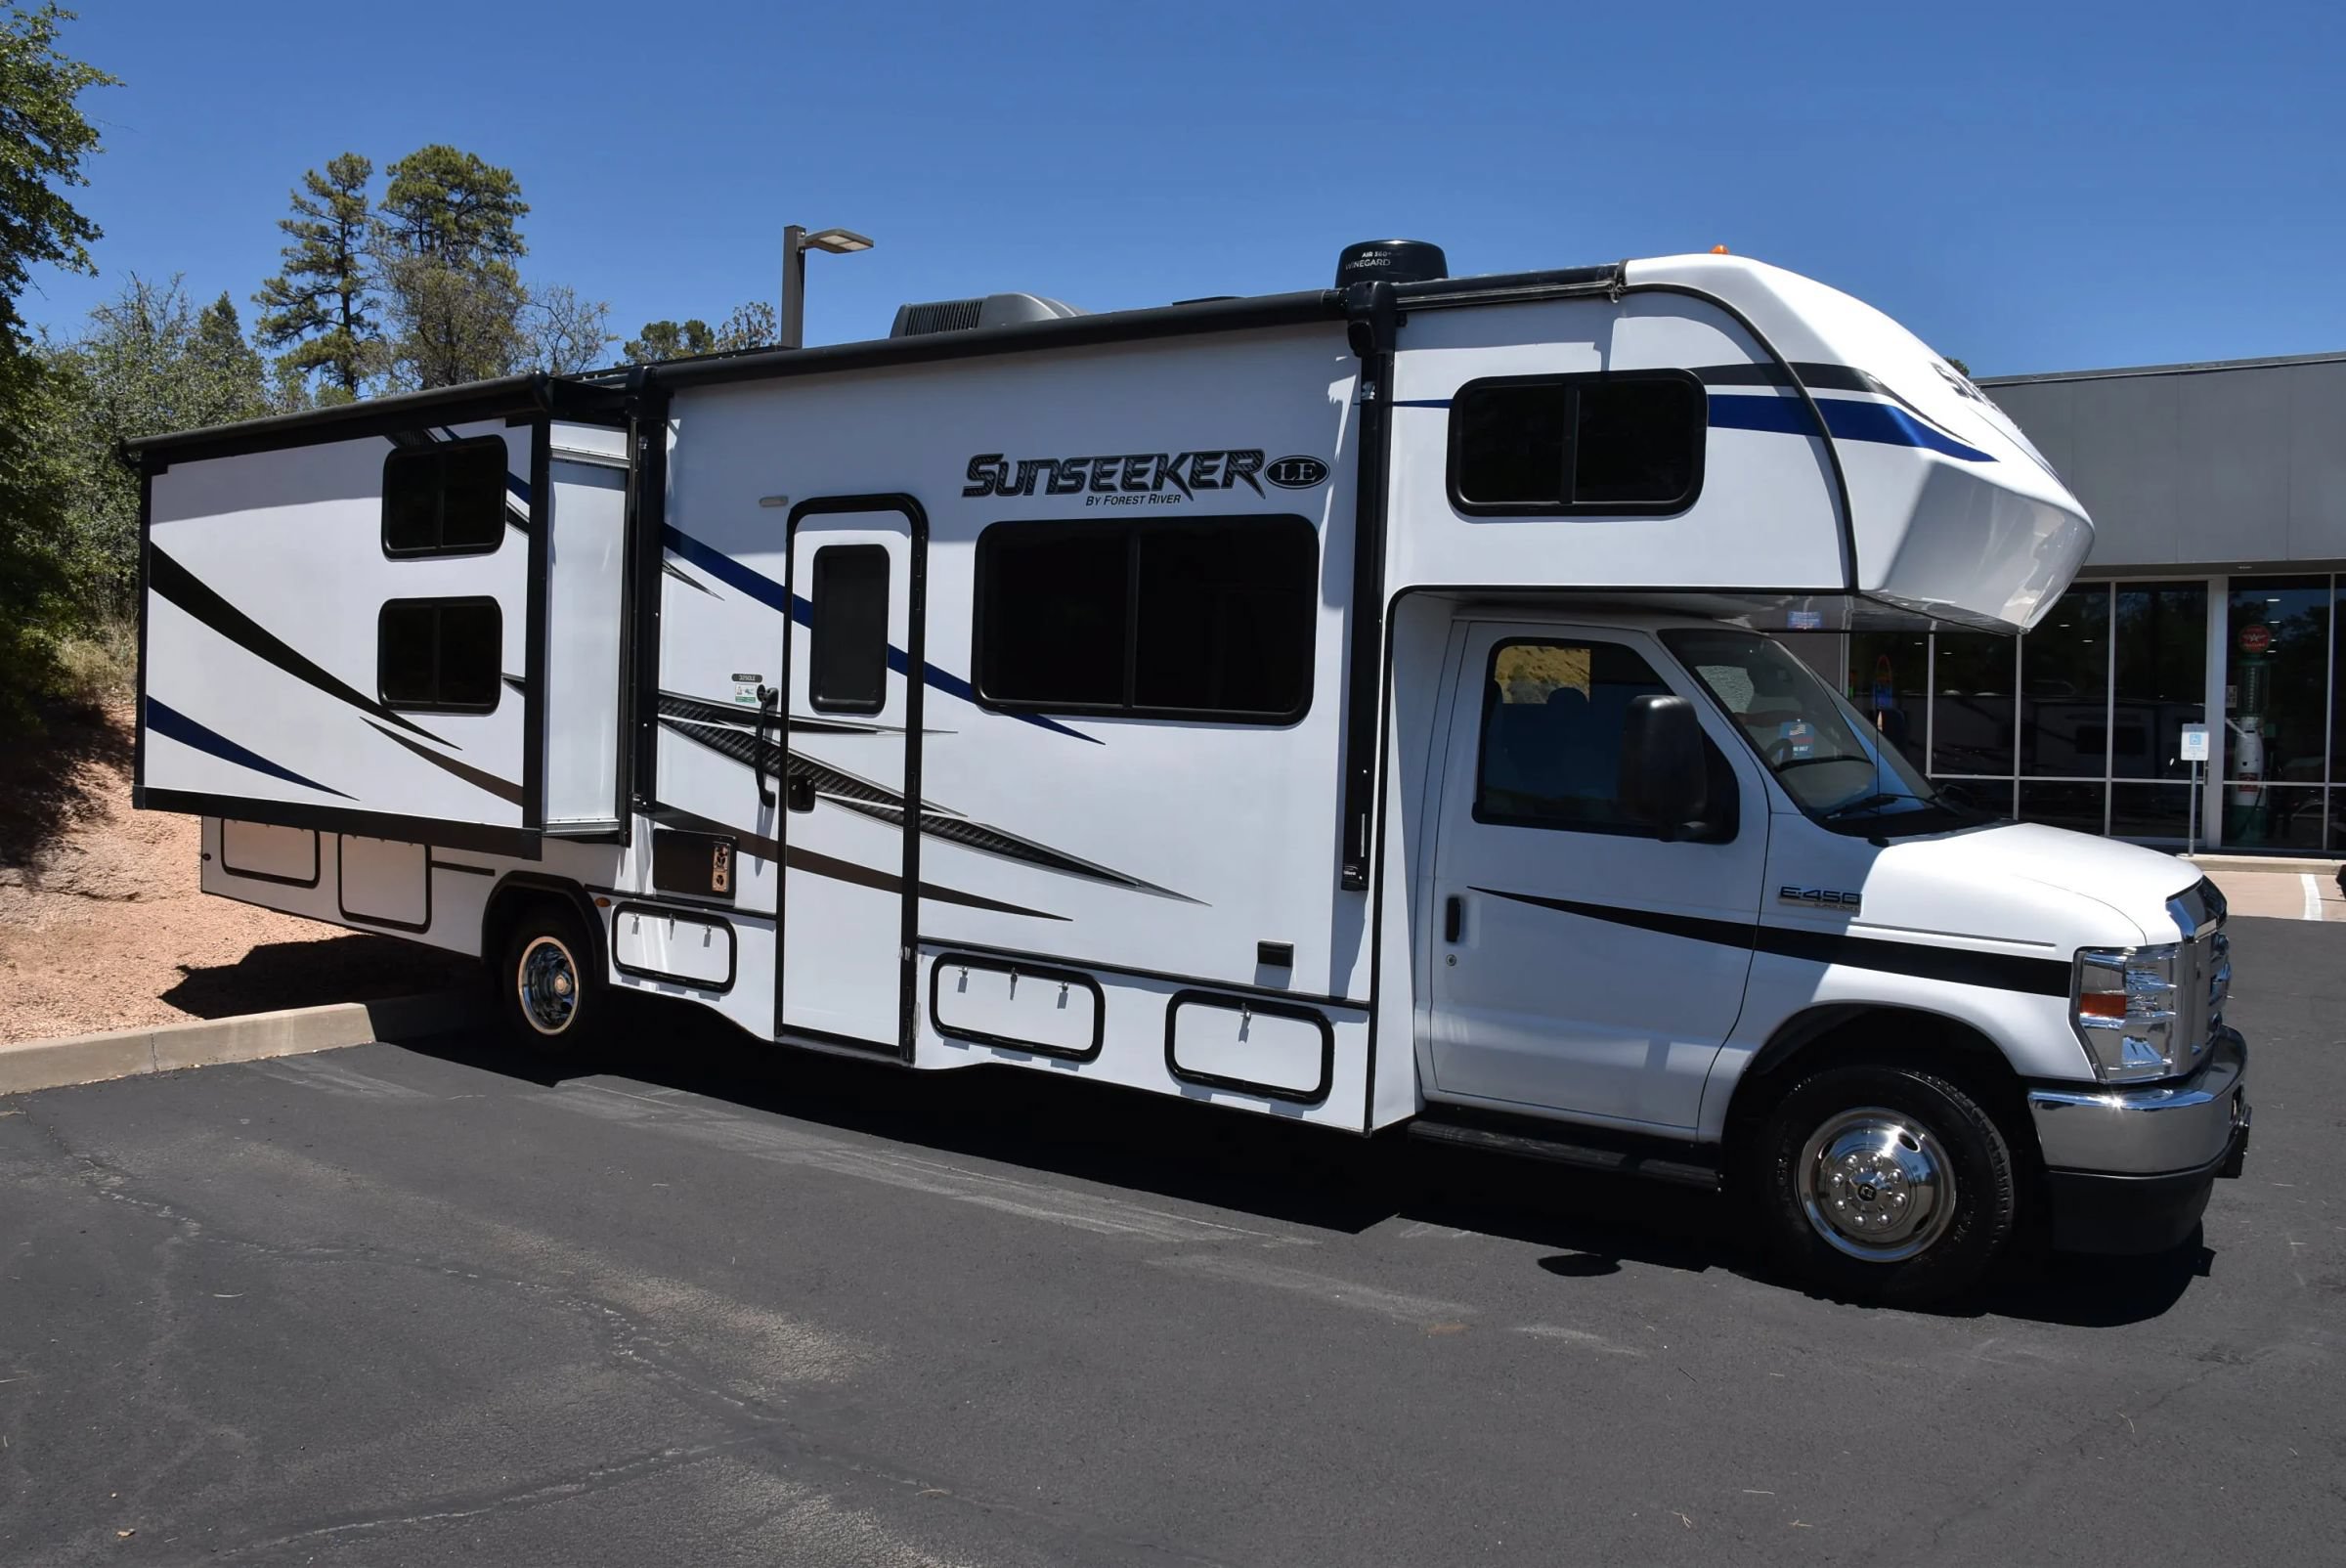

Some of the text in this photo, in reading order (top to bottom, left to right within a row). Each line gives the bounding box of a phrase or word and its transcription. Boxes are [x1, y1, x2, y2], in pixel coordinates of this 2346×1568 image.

[1345, 258, 1391, 271] WINEGARD
[962, 448, 1266, 501] SUNSEEKER
[1278, 461, 1318, 483] LE
[1086, 494, 1182, 506] BY FOREST RIVER
[1780, 886, 1861, 905] E-450
